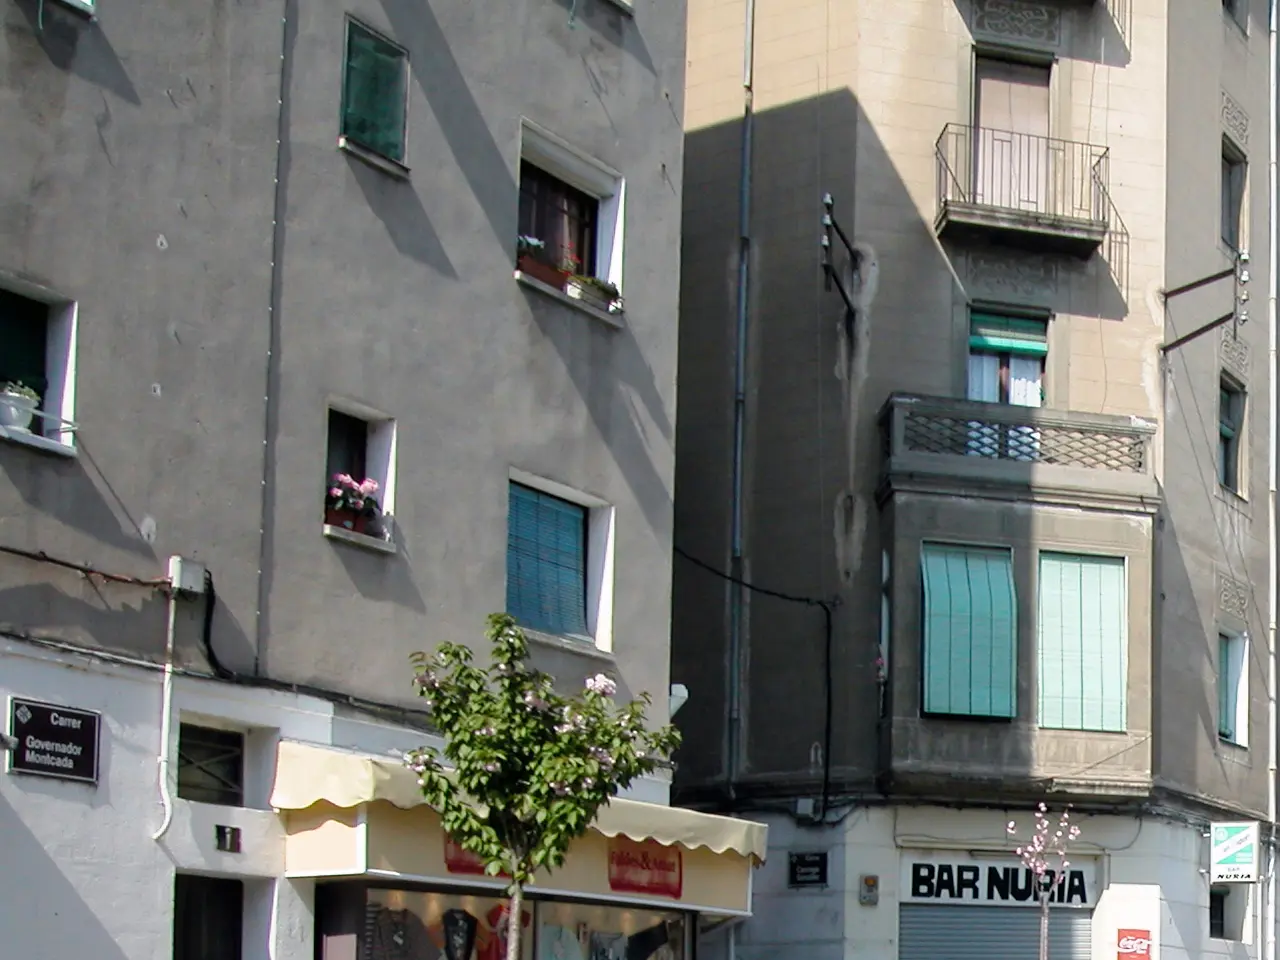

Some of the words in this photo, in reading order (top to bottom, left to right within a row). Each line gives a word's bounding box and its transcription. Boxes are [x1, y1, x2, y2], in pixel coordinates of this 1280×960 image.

[50, 712, 82, 729] Carrer
[25, 735, 82, 756] Governador
[25, 750, 74, 769] Montcada
[912, 863, 980, 899] BAR
